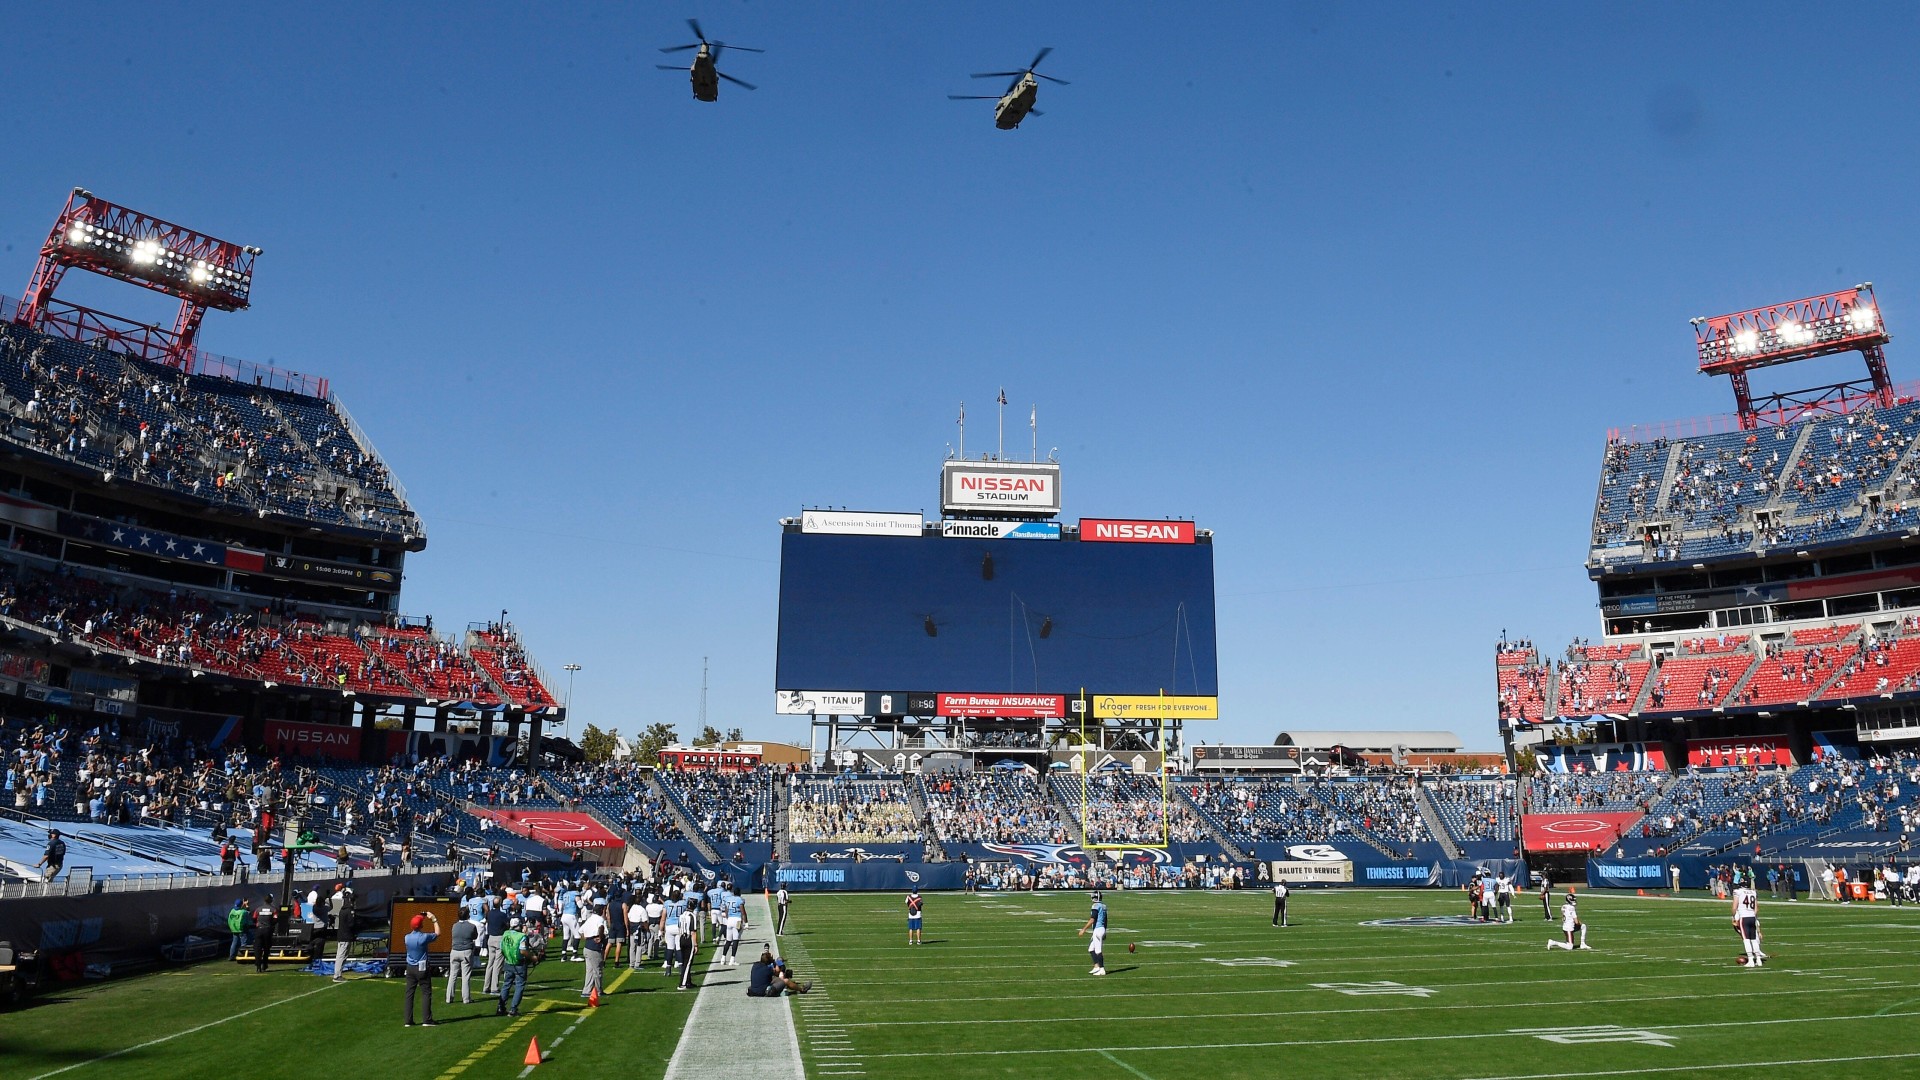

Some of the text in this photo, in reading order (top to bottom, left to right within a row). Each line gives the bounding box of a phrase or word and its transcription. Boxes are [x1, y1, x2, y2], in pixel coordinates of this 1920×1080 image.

[961, 477, 1044, 492] NISSAN
[977, 492, 1029, 501] STADIUM
[821, 518, 922, 530] Ascension Saint Thomas
[944, 522, 999, 536] Pinnacle
[1012, 531, 1059, 540] TitansBanking.com
[1096, 523, 1179, 539] NISSAN
[303, 563, 310, 571] 0
[356, 570, 362, 578] 0
[1603, 604, 1621, 612] 12:00
[821, 696, 864, 705] TITAN UP
[944, 696, 1057, 707] Farm Bureau INSURANCE
[1099, 698, 1132, 717] Kroger
[276, 728, 350, 745] NISSAN
[1700, 742, 1776, 756] NISSAN
[1810, 840, 1900, 848] NISSAN
[776, 869, 845, 883] TENNESSEE TOUGH
[1278, 866, 1341, 875] SALUTE TO SERVICE
[1366, 866, 1429, 880] TENNESSEE TOUGH
[1599, 864, 1662, 879] TENNESSEE TOUGH
[1485, 880, 1494, 890] 31
[1853, 885, 1861, 895] G
[727, 901, 737, 914] 75
[1742, 895, 1756, 910] 48
[668, 905, 683, 918] 70
